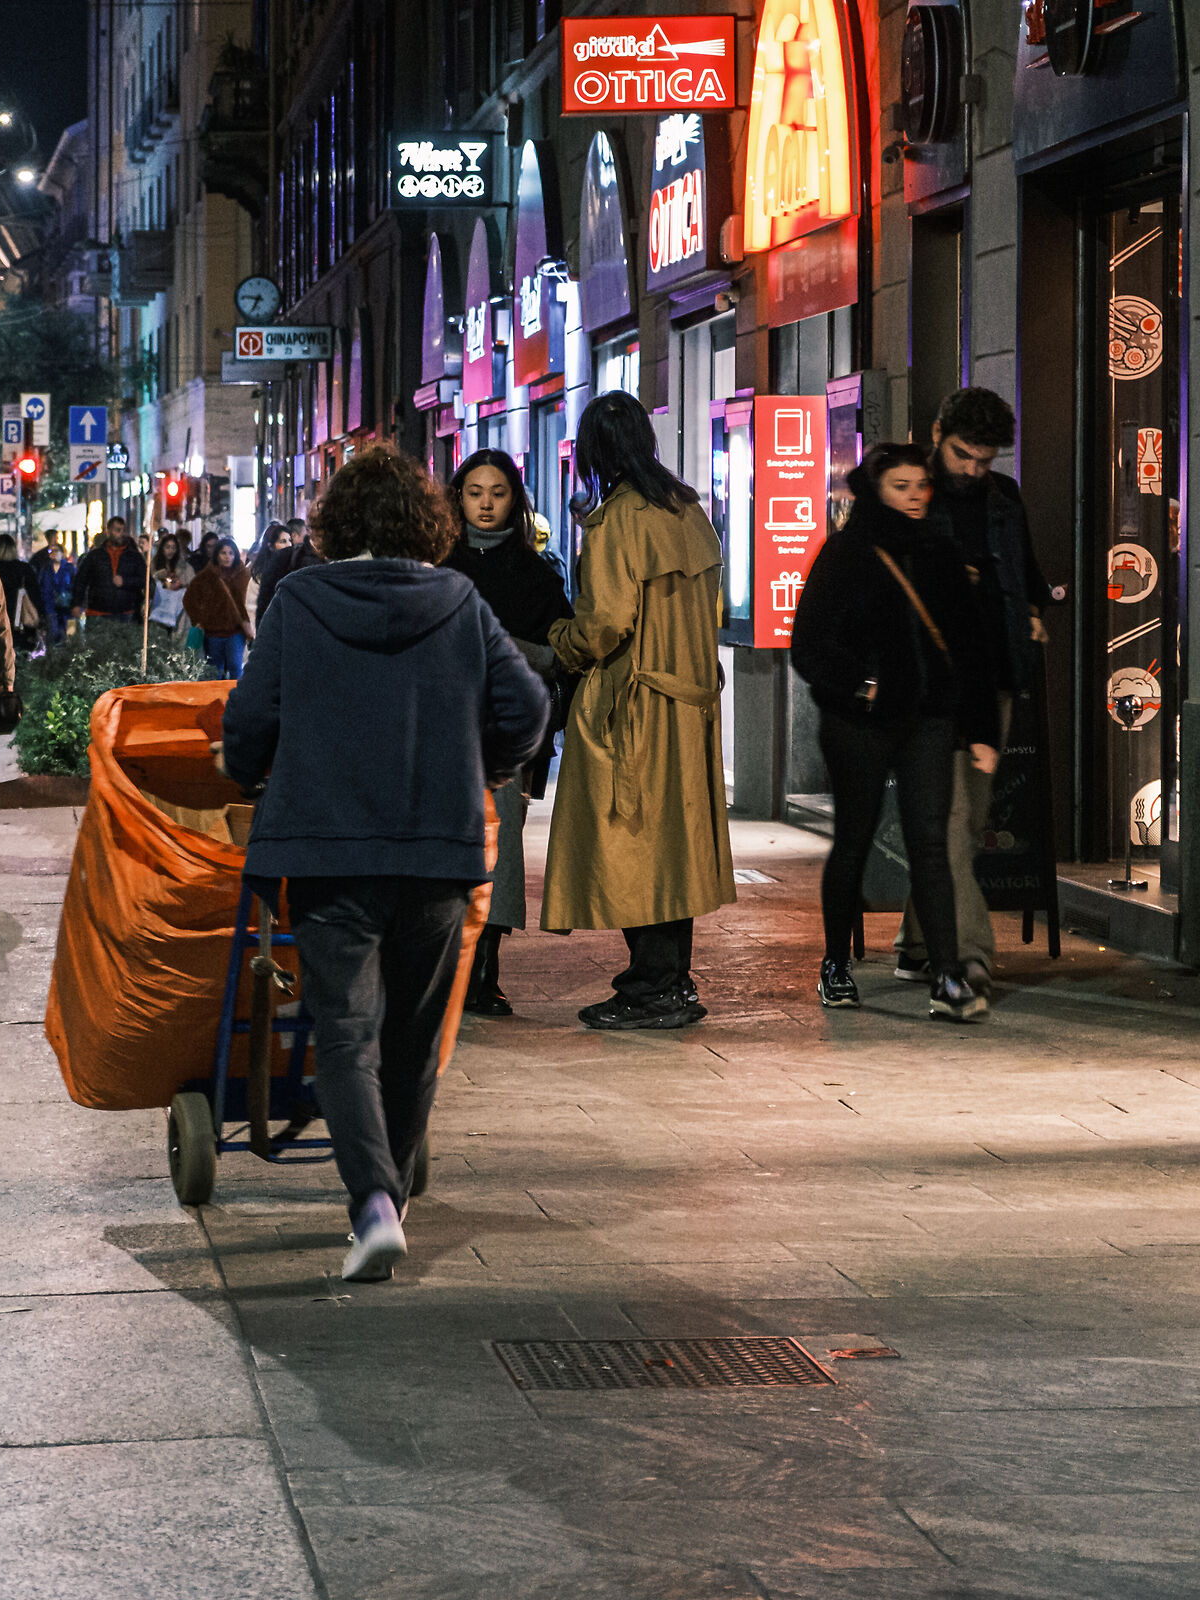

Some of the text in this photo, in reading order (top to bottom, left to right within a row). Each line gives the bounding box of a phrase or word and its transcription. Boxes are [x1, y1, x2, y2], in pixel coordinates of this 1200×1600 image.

[573, 35, 655, 62] giudici
[574, 68, 727, 105] OTTICA
[649, 168, 704, 274] OTTICA
[766, 459, 815, 468] Smartphone
[778, 471, 805, 480] Repair
[772, 534, 809, 543] Computer
[777, 546, 806, 555] Service
[979, 874, 1041, 889] AKITORI
